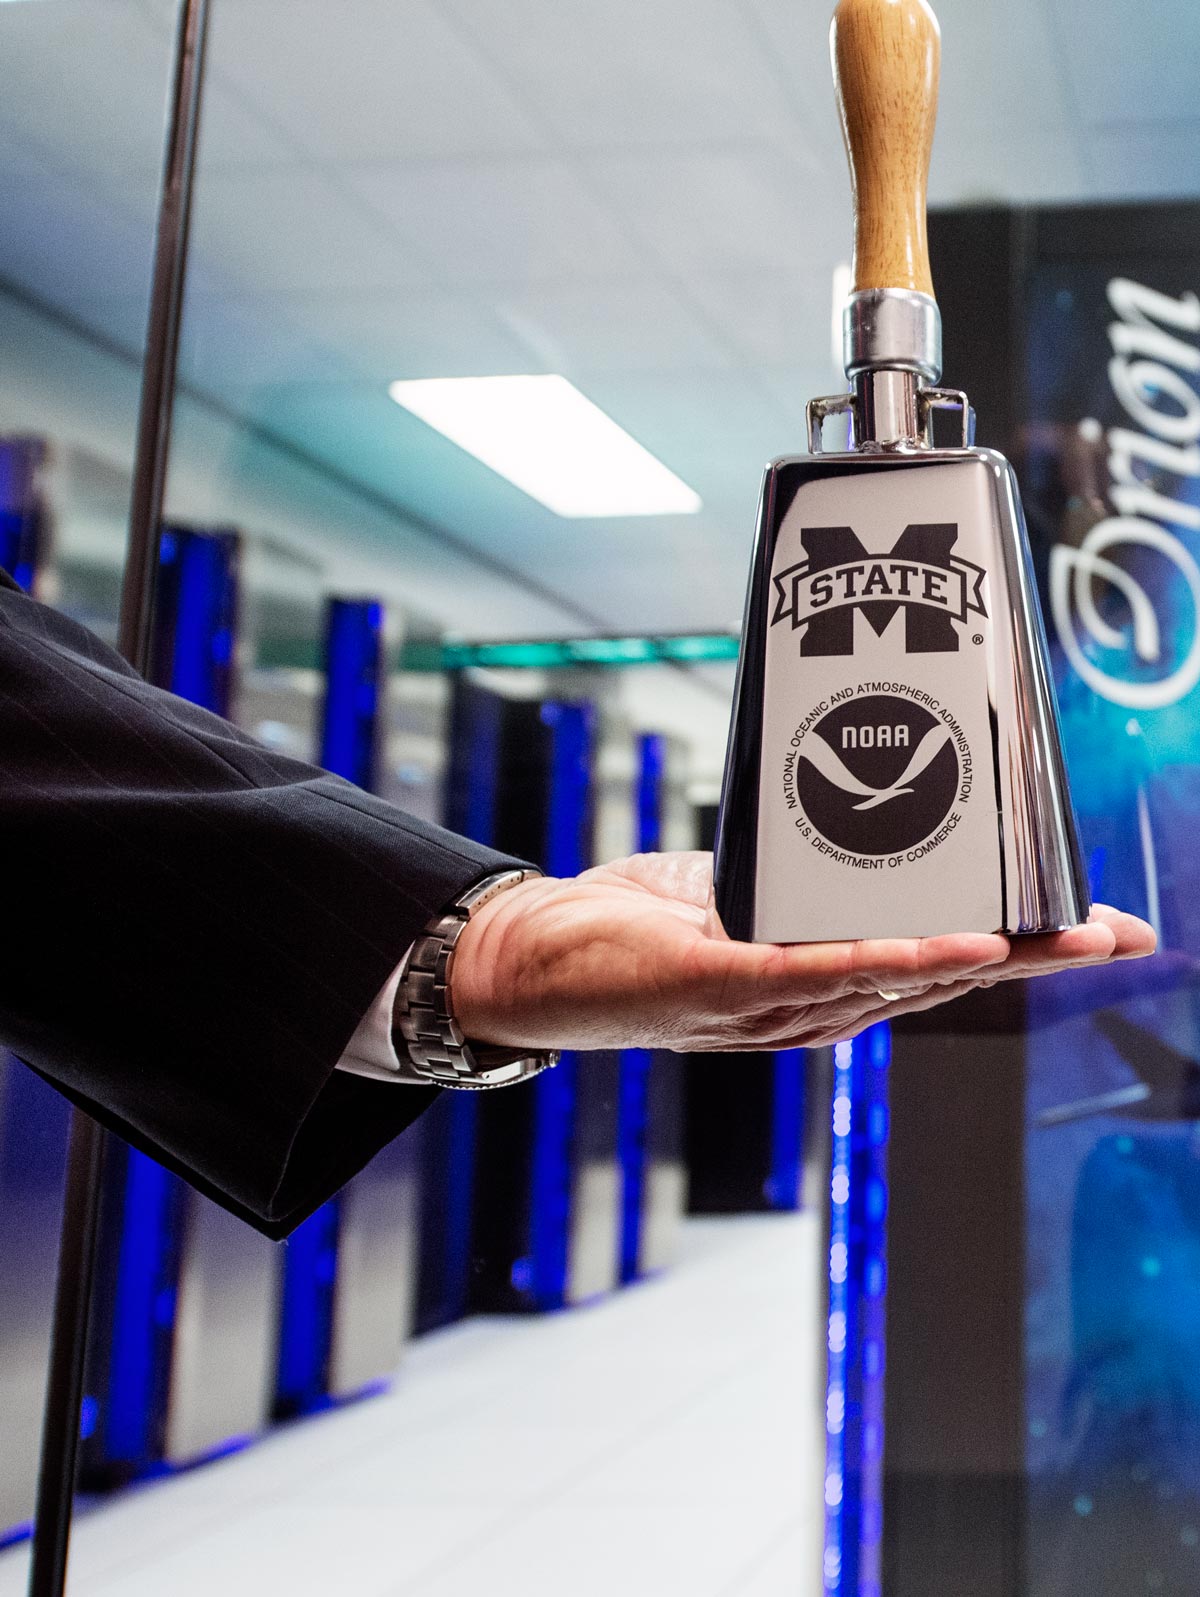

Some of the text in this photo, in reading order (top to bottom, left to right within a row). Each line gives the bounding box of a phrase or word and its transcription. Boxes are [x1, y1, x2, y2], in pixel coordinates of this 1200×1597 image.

[810, 563, 948, 608] STATE
[783, 681, 973, 810] NATIONAL OCEANIC AND ATMOSPHERIC ADMINISTRATION
[842, 724, 910, 749] NOAA
[794, 812, 962, 870] U.S. DEPARTMENT OF COMMERCE
